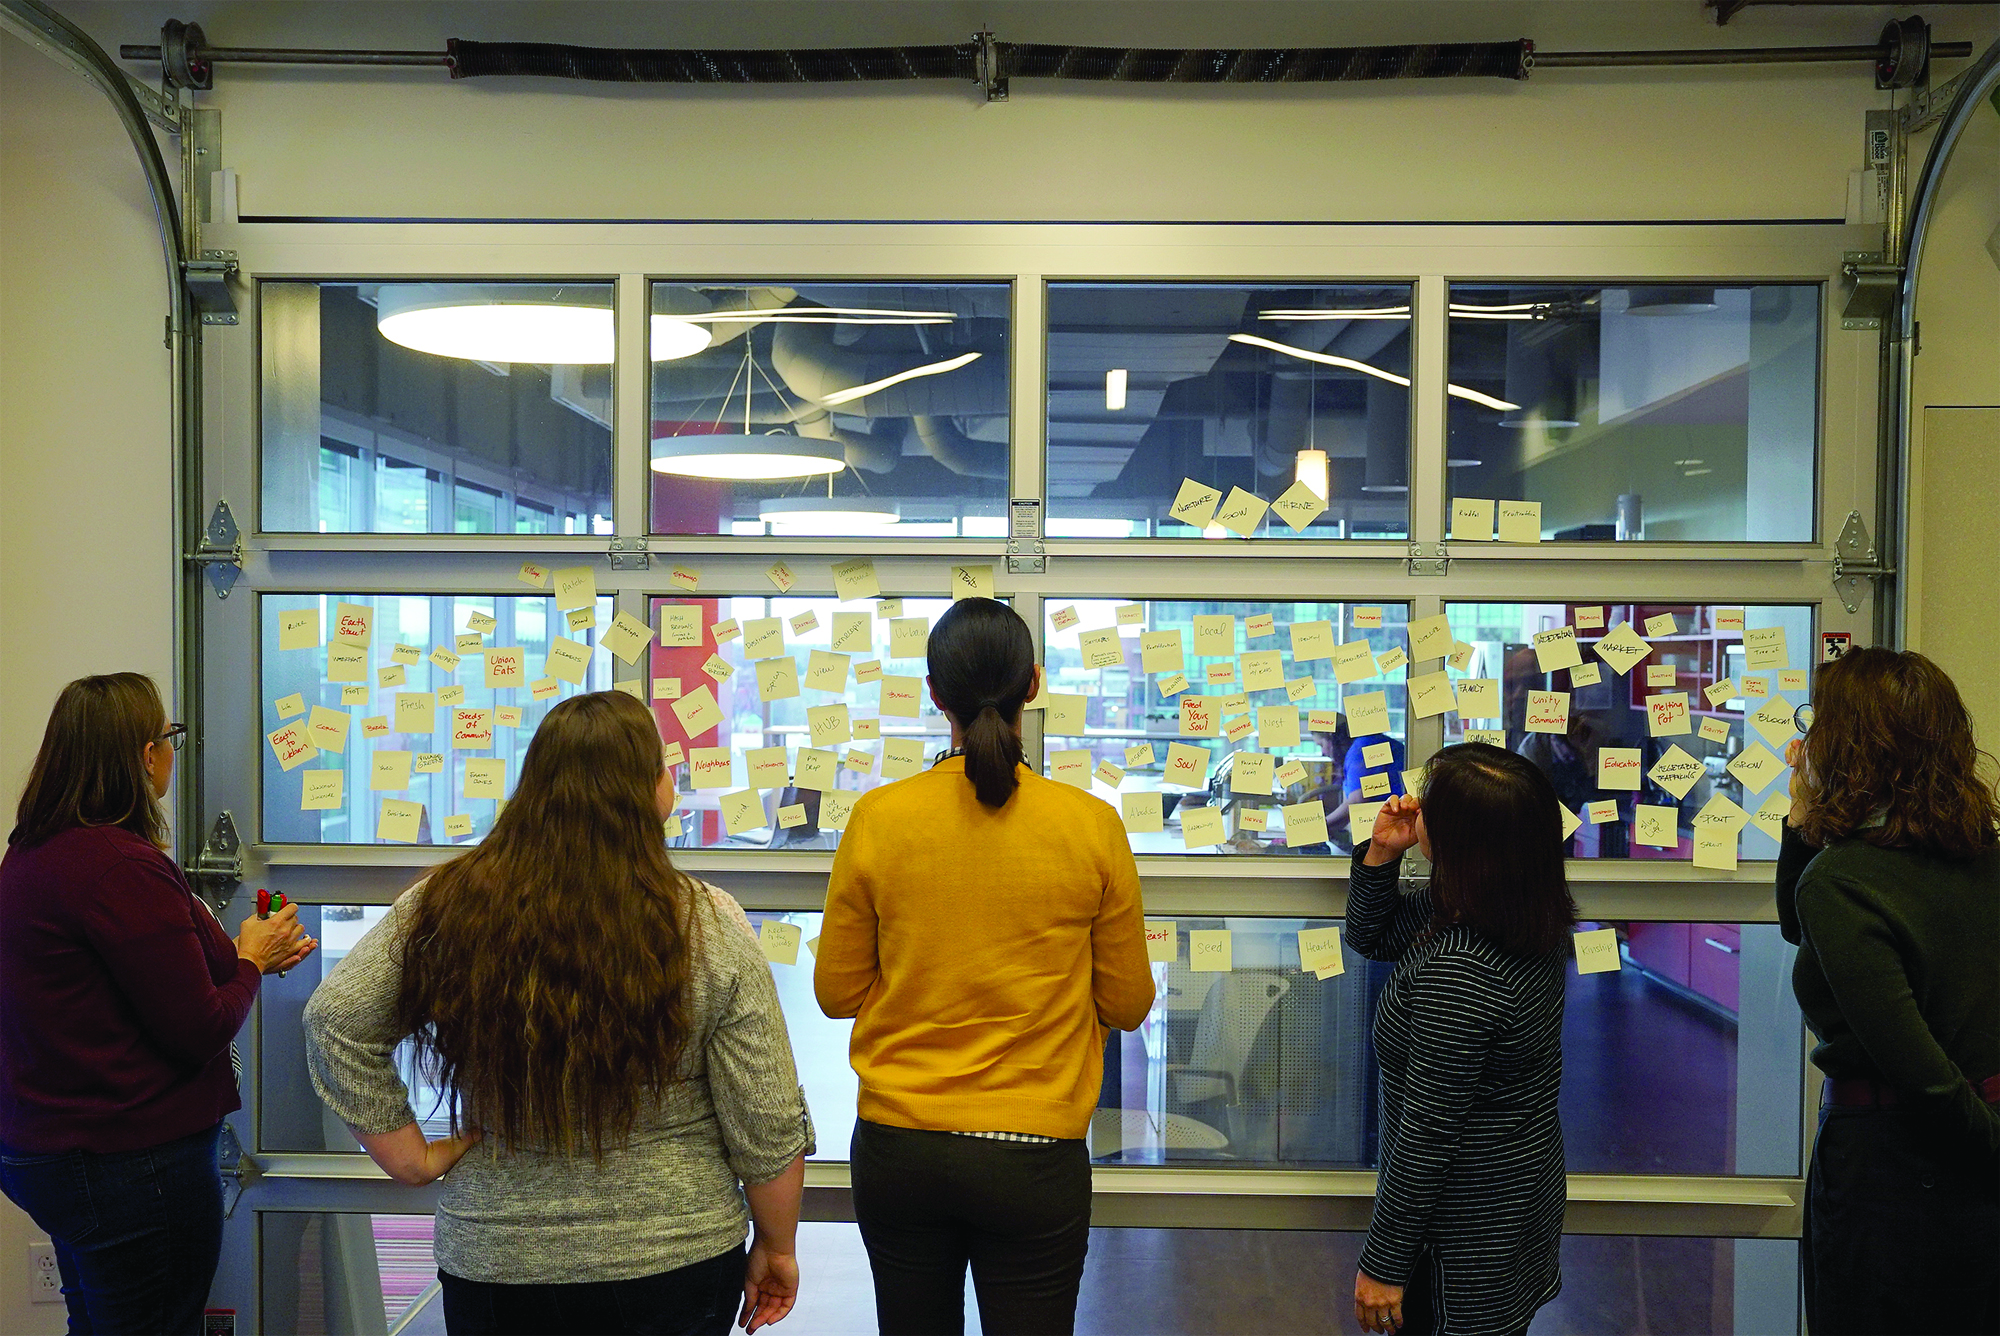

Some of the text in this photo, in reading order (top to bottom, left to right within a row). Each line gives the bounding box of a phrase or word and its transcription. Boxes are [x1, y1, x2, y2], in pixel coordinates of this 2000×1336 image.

[1178, 494, 1213, 513] NURTURE
[1223, 507, 1247, 520] SOW
[1200, 623, 1226, 636] Local
[1602, 644, 1643, 654] MARKET
[491, 656, 515, 664] Union
[493, 665, 516, 676] Eats
[400, 700, 425, 711] Fresh
[1183, 699, 1202, 709] Feed
[1653, 702, 1684, 716] Melting
[458, 712, 484, 720] Seeds
[1658, 713, 1674, 725] Pot
[1757, 713, 1790, 725] BLOOM
[814, 716, 840, 735] HUB
[1189, 721, 1208, 731] Soul
[273, 730, 297, 745] Earth
[455, 730, 491, 741] Community
[286, 740, 295, 748] to
[282, 744, 308, 760] Urban
[1174, 758, 1197, 772] Soul
[1604, 758, 1640, 768] Education
[1734, 760, 1763, 769] GROW
[1581, 943, 1613, 956] Kinship
